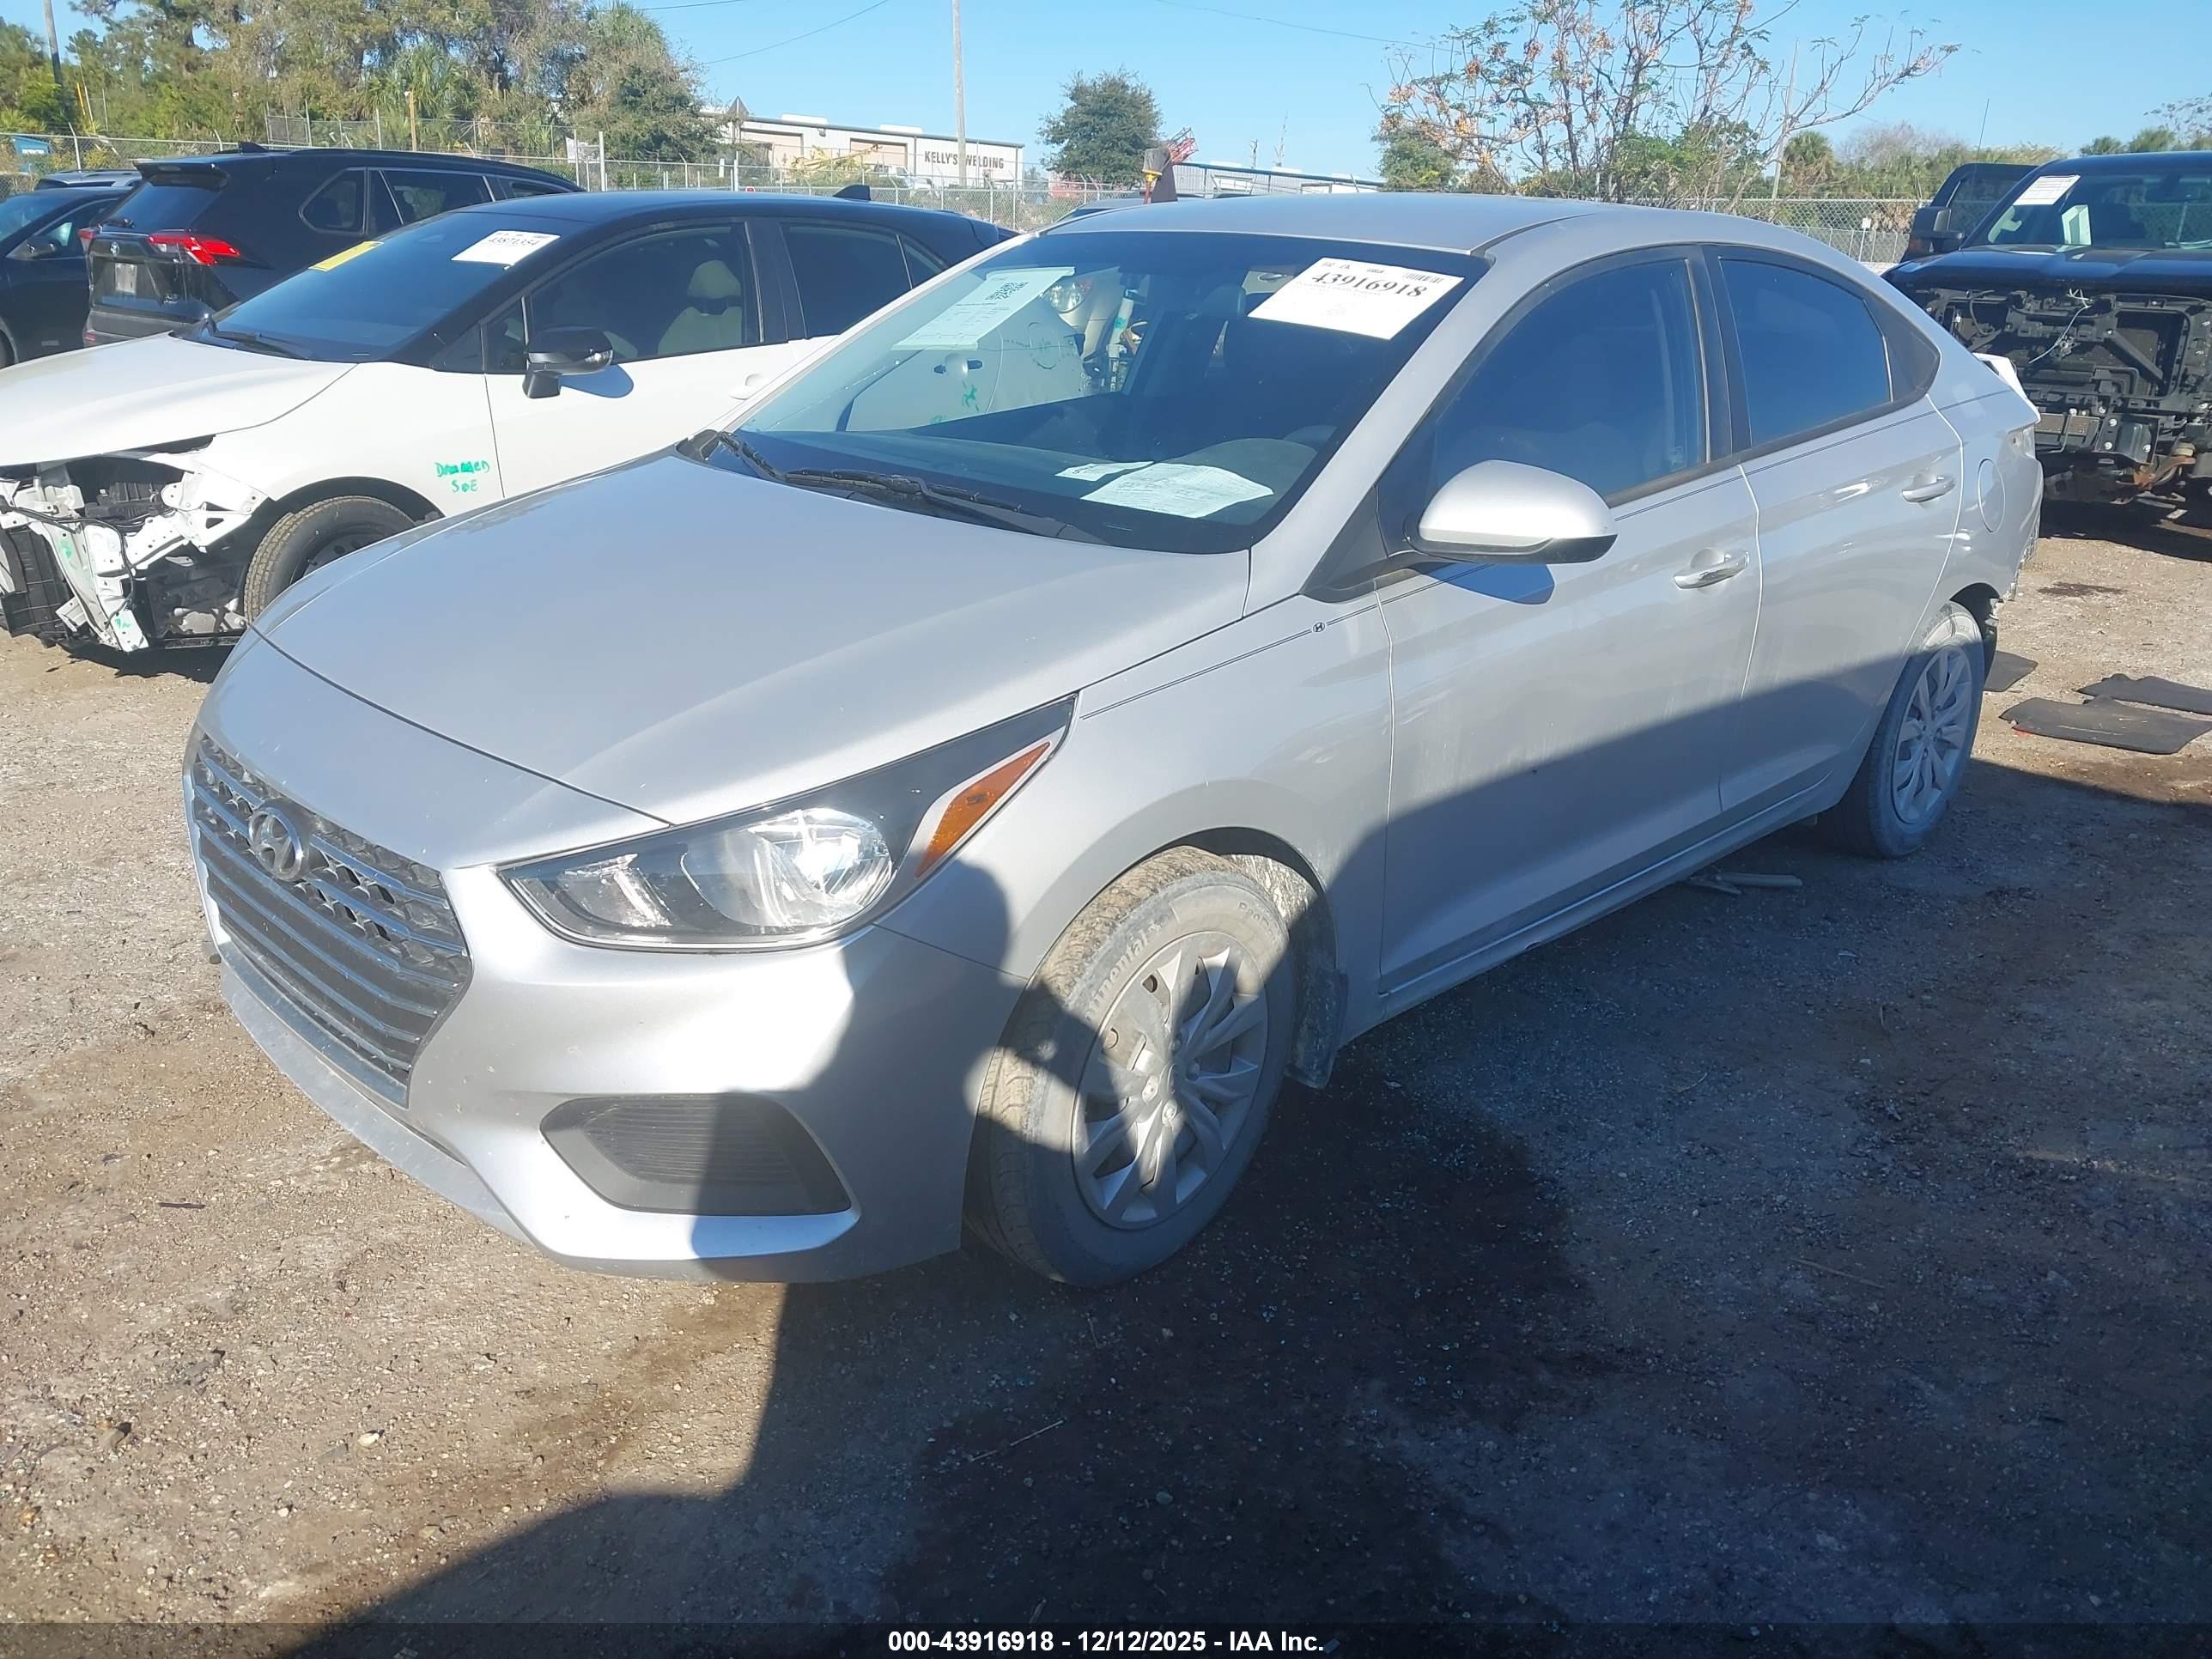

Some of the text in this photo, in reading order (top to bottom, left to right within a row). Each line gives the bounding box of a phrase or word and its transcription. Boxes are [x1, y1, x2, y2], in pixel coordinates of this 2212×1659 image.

[924, 150, 1004, 168] KELLY'S WELDING
[1312, 271, 1427, 297] 43916918
